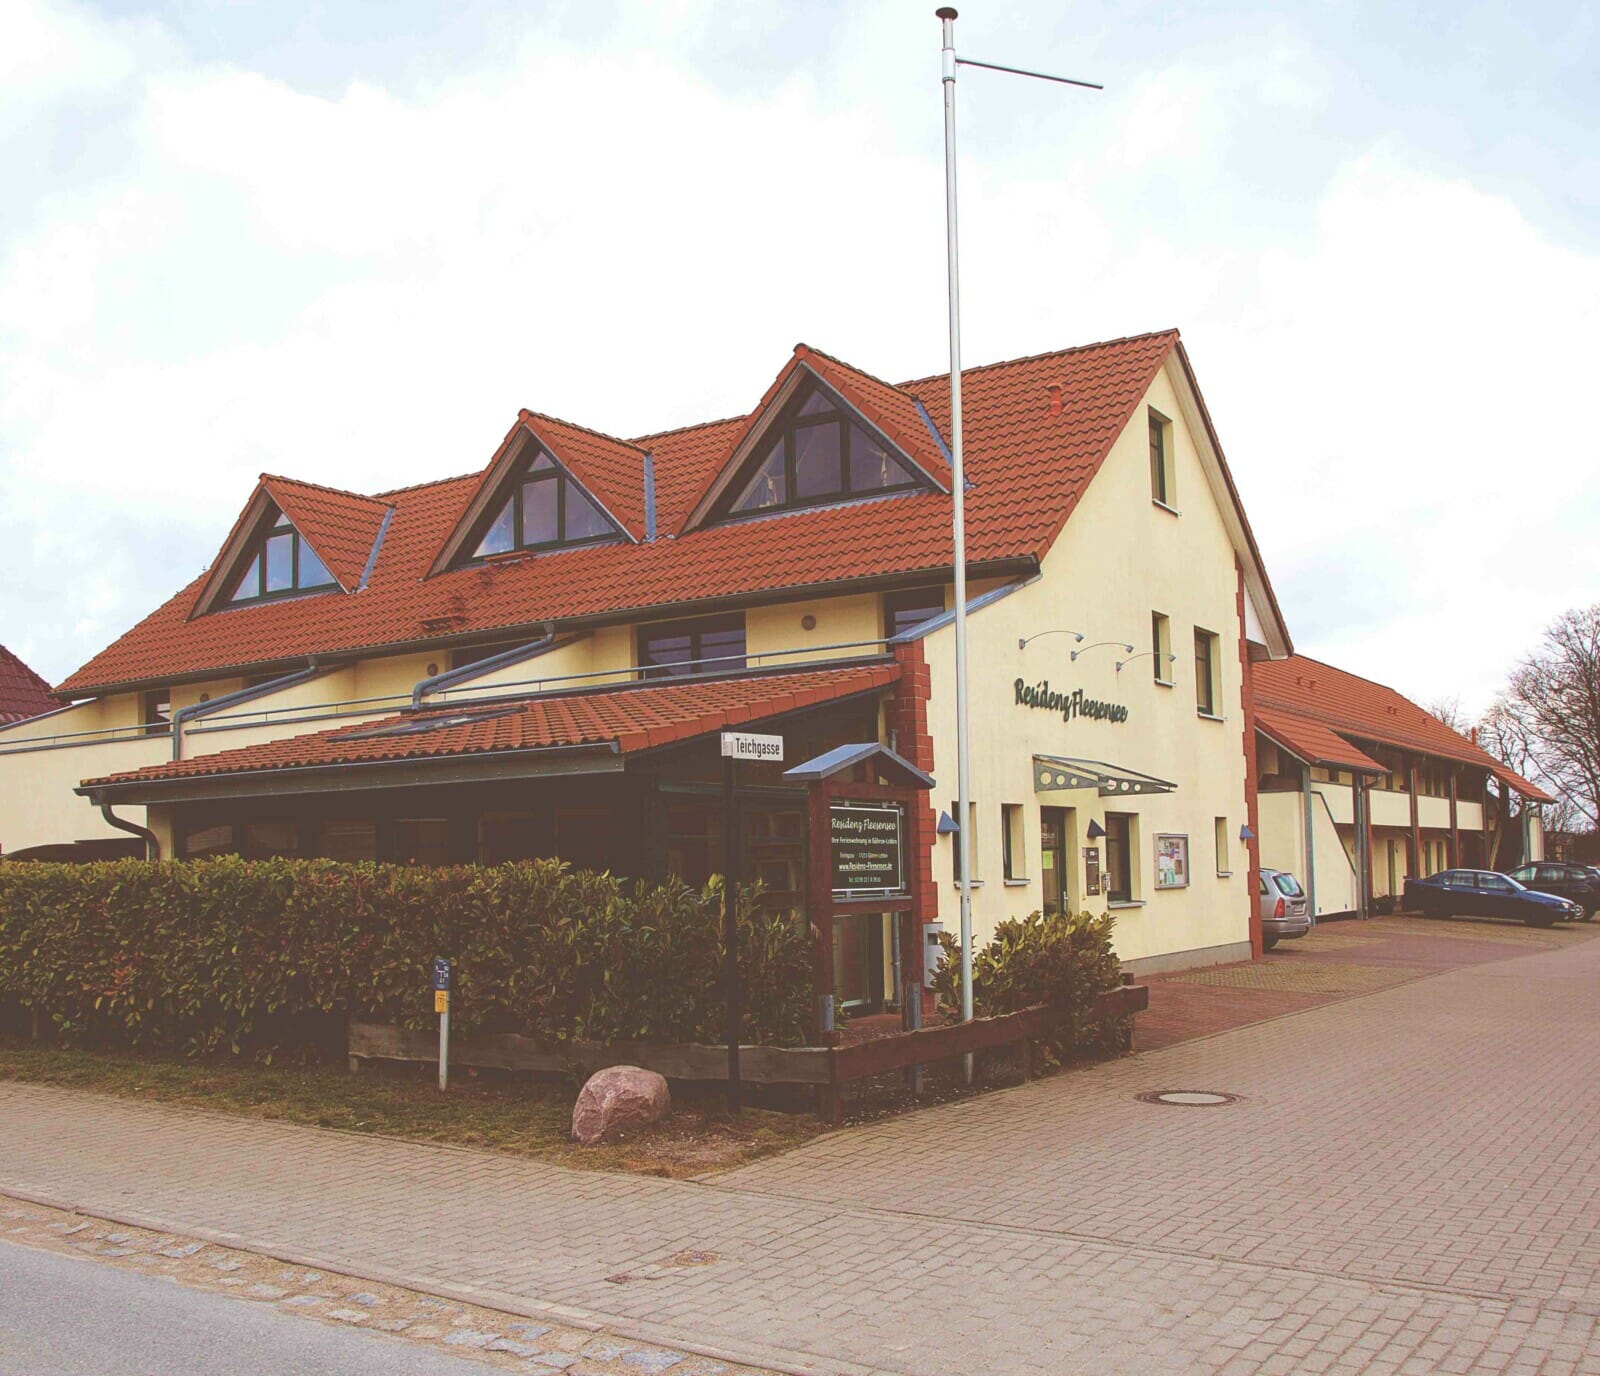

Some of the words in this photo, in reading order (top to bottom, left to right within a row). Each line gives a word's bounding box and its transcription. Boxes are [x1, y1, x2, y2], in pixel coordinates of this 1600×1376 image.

[1014, 677, 1072, 723] Residenz
[1070, 688, 1128, 723] Fleesensee
[735, 737, 780, 758] Teichgasse
[831, 817, 863, 833] Residenz
[863, 818, 896, 831] Fleesensee
